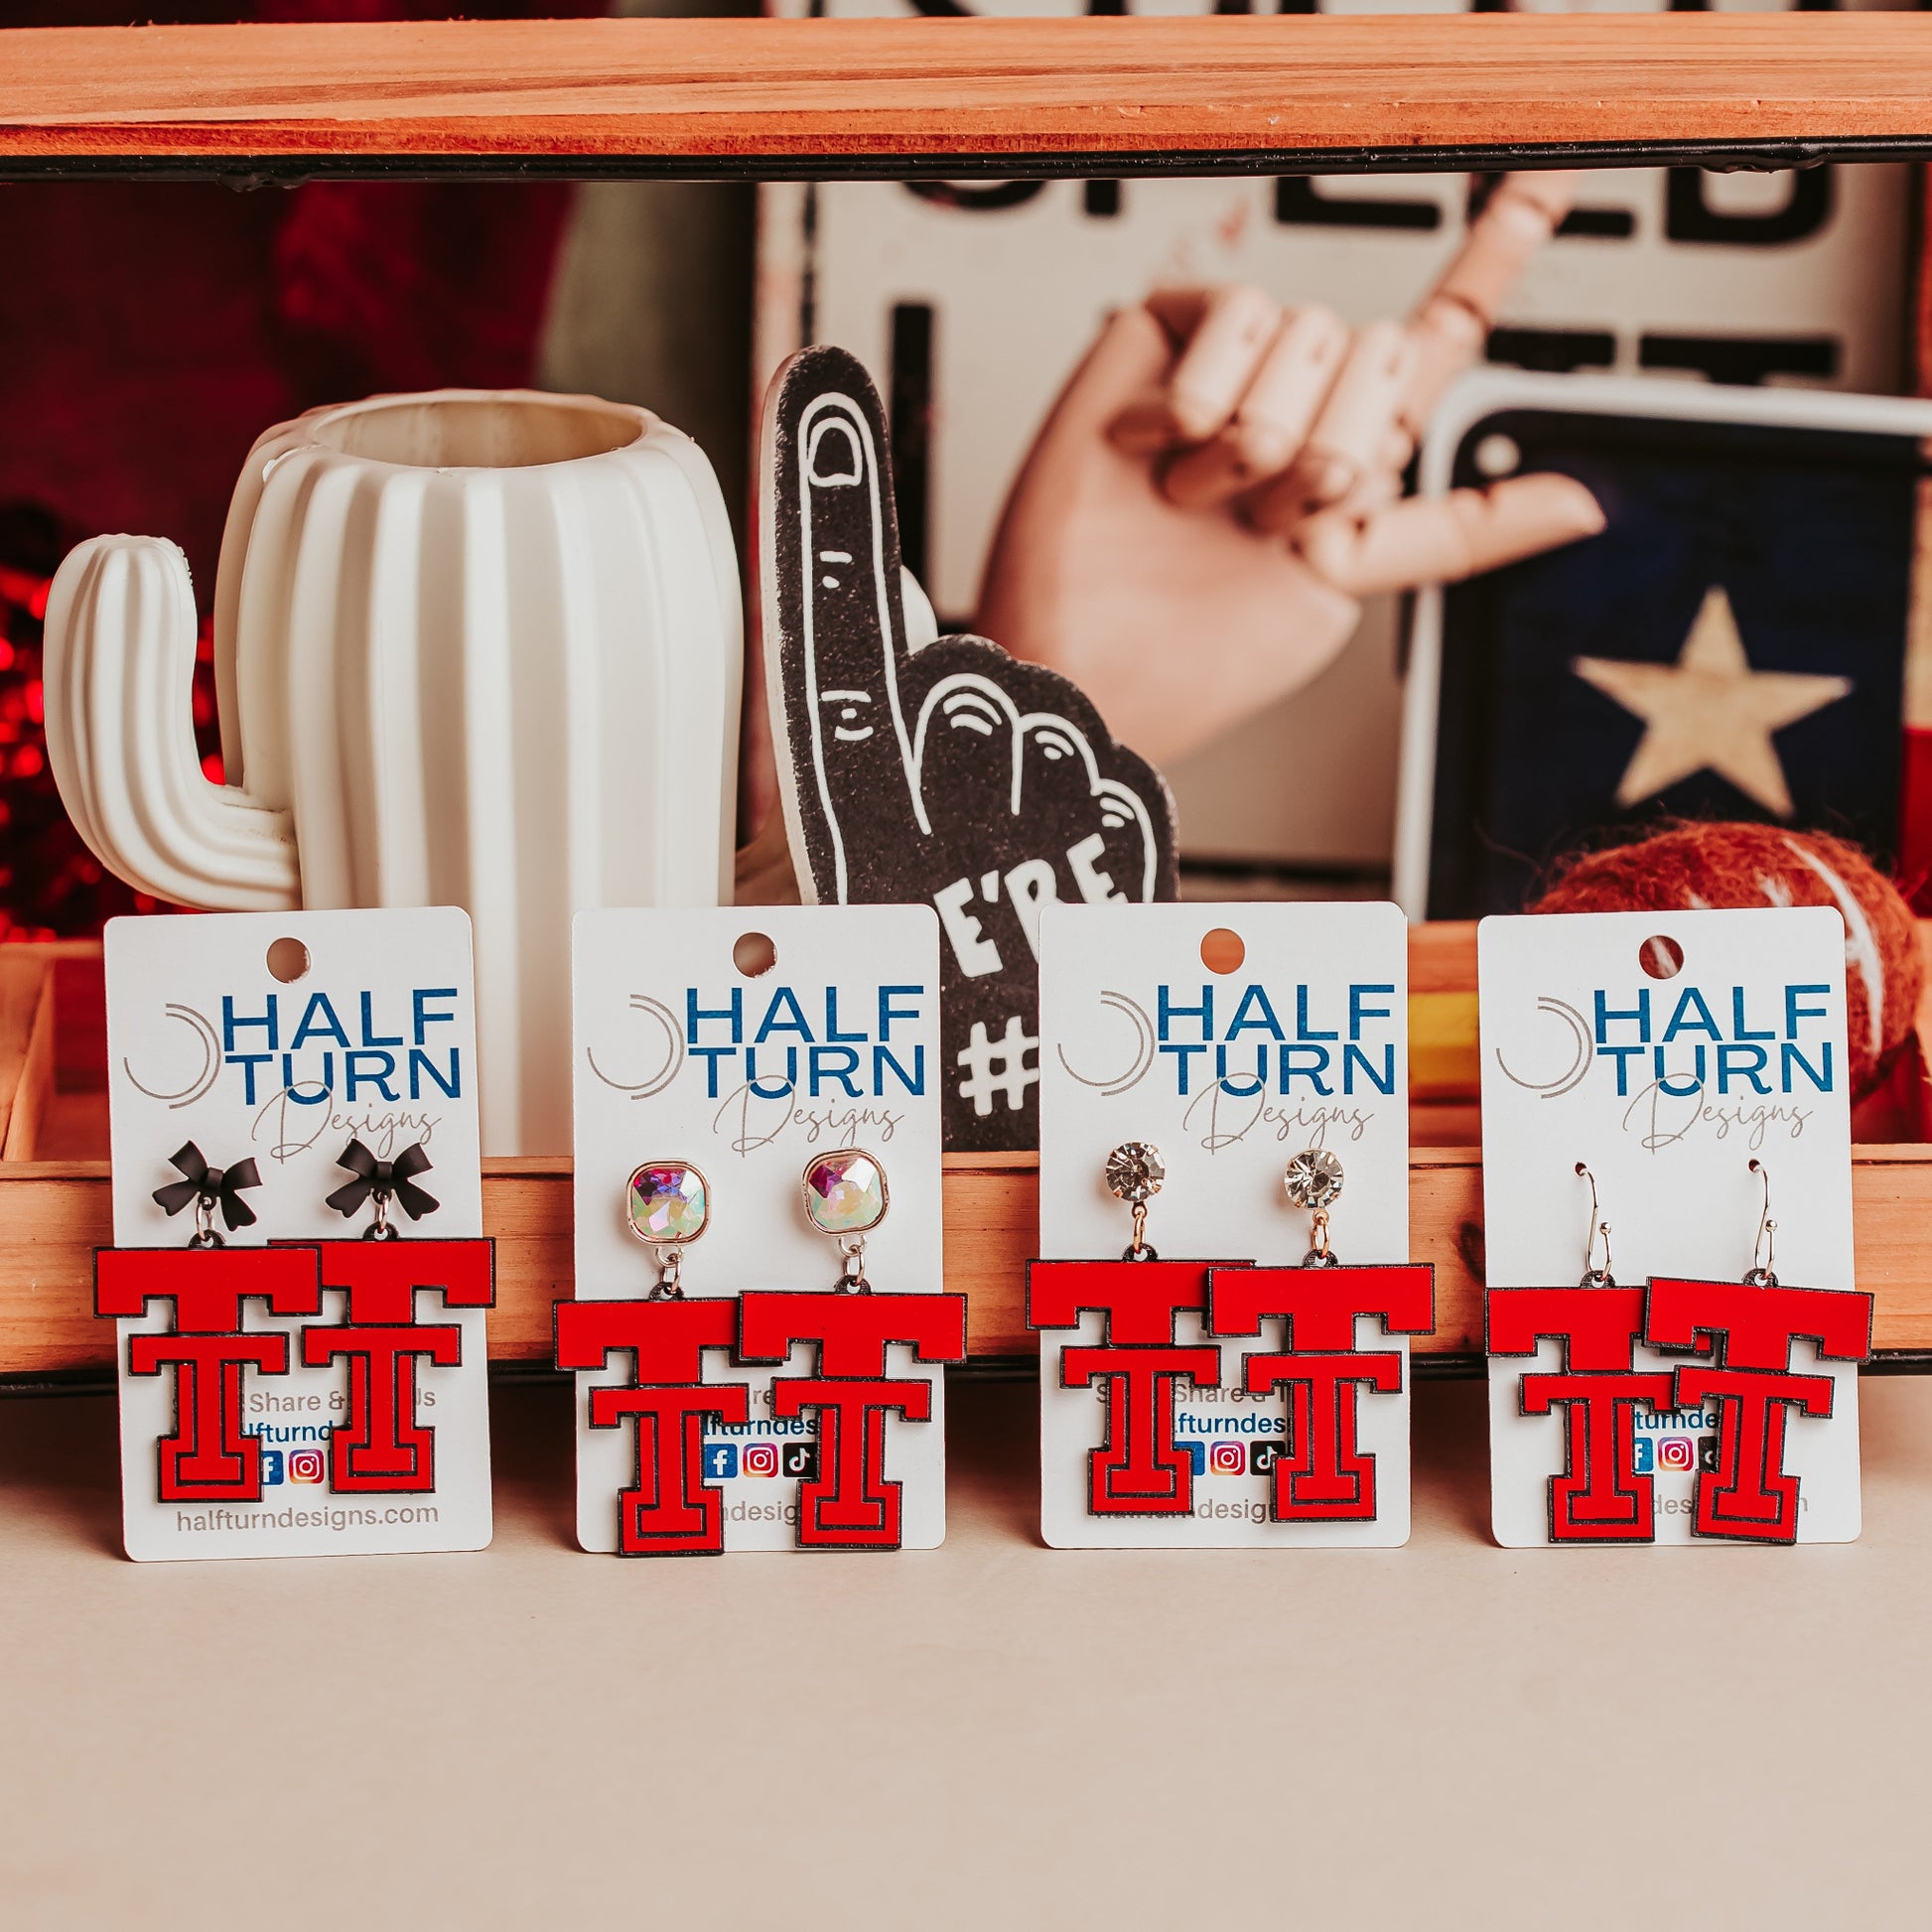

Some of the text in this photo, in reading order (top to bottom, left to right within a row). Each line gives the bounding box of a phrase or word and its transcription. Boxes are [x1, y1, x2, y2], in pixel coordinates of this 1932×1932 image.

[221, 988, 458, 1052] HALF
[686, 984, 925, 1044] HALF
[1157, 983, 1395, 1041] HALF
[1593, 984, 1831, 1044] HALF
[224, 1047, 462, 1106] TURN
[687, 1044, 925, 1100] TURN
[1158, 1043, 1395, 1097] TURN
[1596, 1041, 1834, 1097] TURN
[251, 1080, 442, 1165] Designs
[713, 1074, 904, 1158] Designs
[1182, 1072, 1374, 1156] Designs
[1622, 1072, 1814, 1155] Designs
[248, 1391, 322, 1413] Share
[329, 1390, 346, 1411] &
[1174, 1413, 1287, 1434] fturndes
[177, 1504, 440, 1533] halfturndesigns.com
